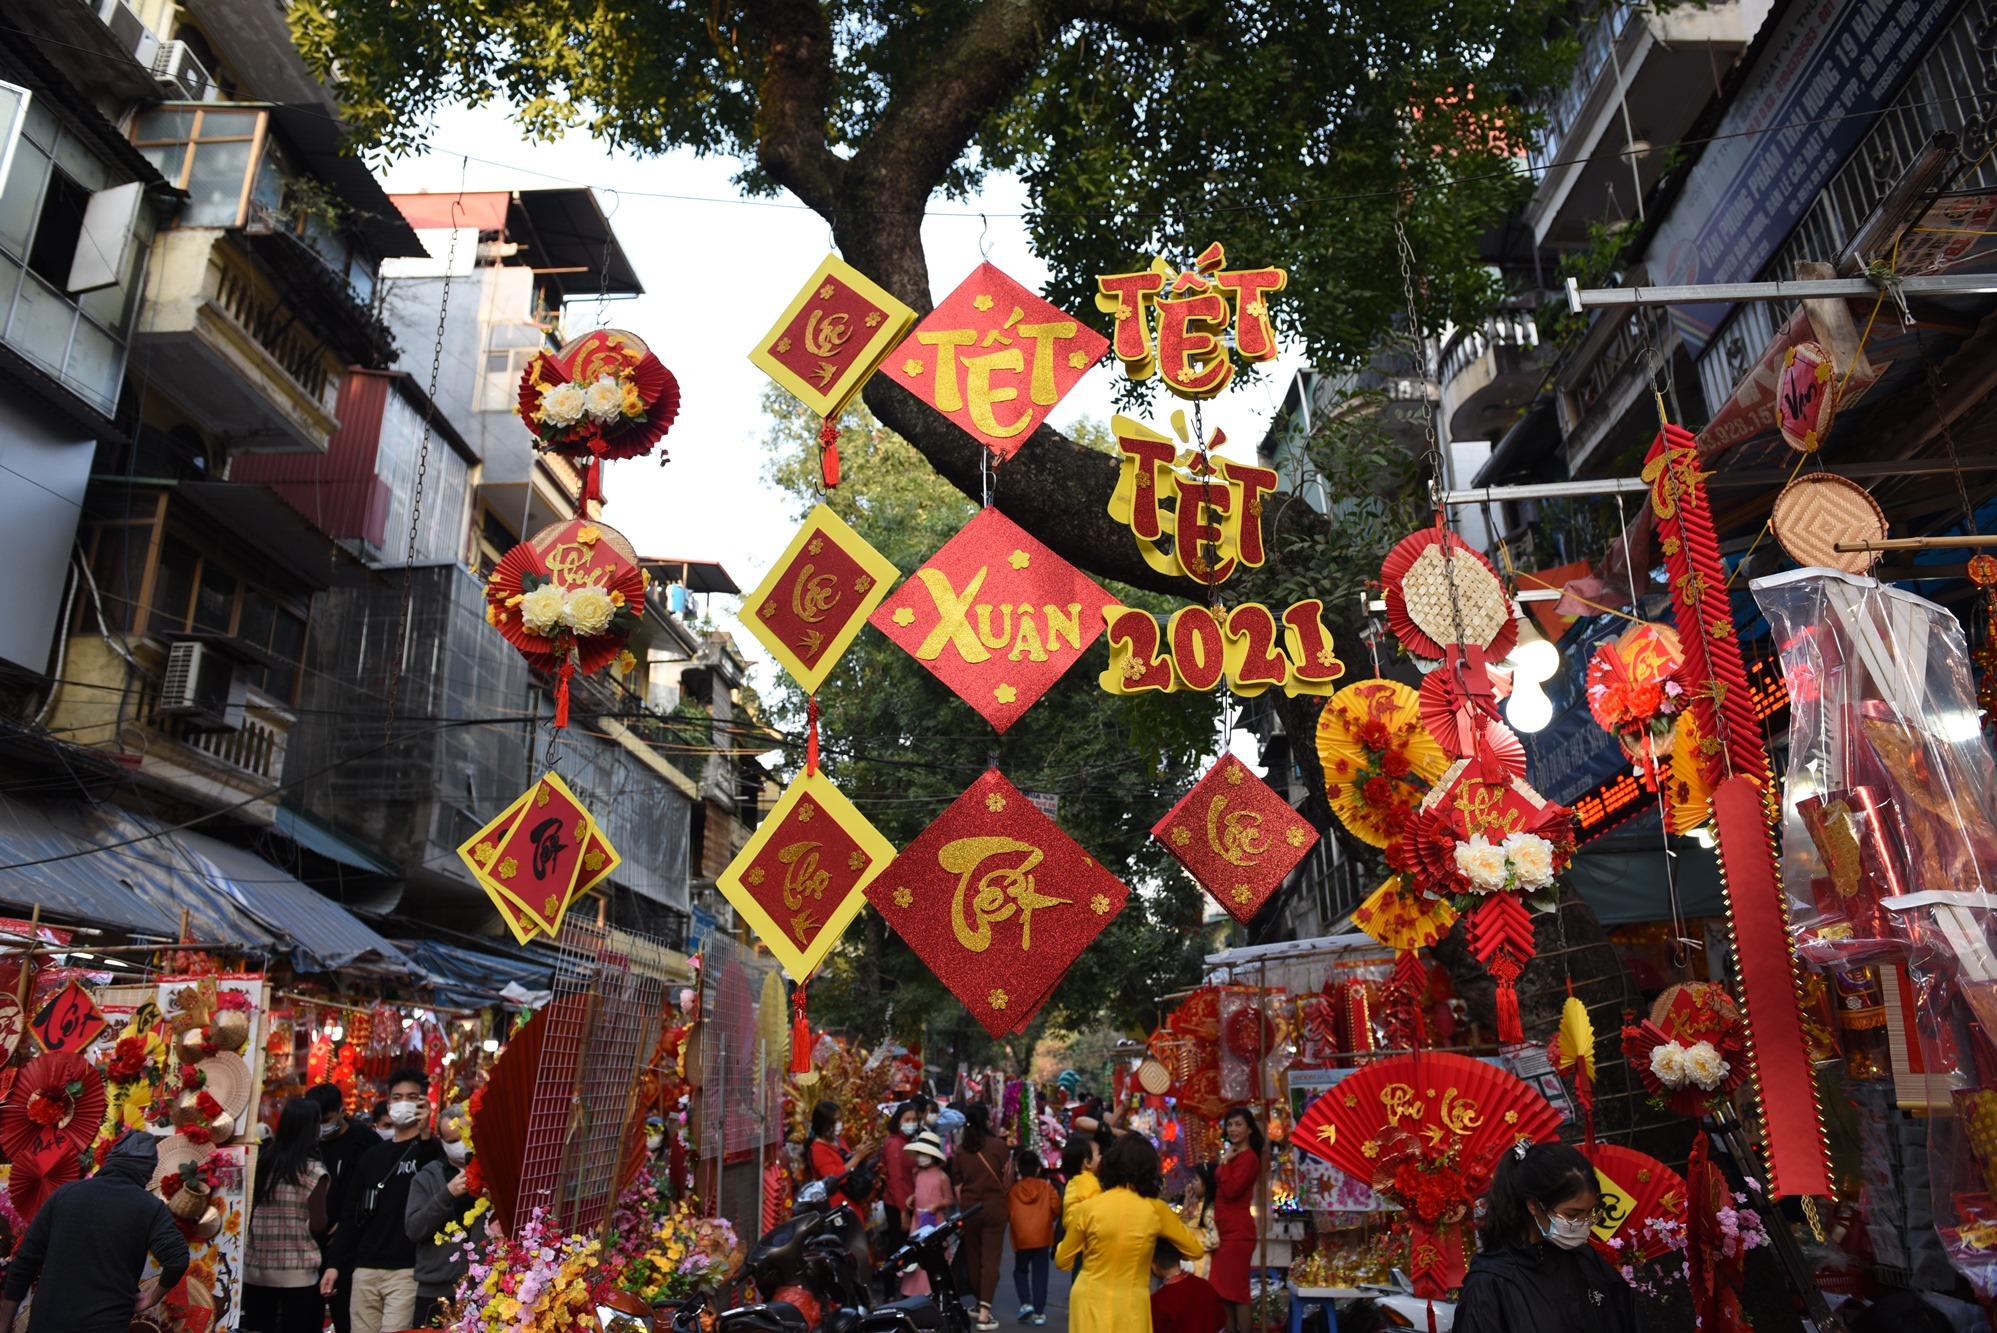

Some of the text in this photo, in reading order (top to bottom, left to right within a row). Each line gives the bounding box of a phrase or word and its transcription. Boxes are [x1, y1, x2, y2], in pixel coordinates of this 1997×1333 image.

[1775, 105, 1809, 154] THÁI
[1831, 30, 1861, 69] 19
[1857, 52, 1878, 81] ĐỒ
[1870, 19, 1902, 63] DÙNG
[916, 306, 1078, 439] TẾT
[1097, 242, 1287, 398] TẾT
[1697, 403, 1779, 454] 3.928.15
[1112, 425, 1278, 586] TẾT
[1103, 598, 1346, 695] 2021
[938, 836, 1074, 953] Tết
[1594, 1193, 1626, 1230] ộc
